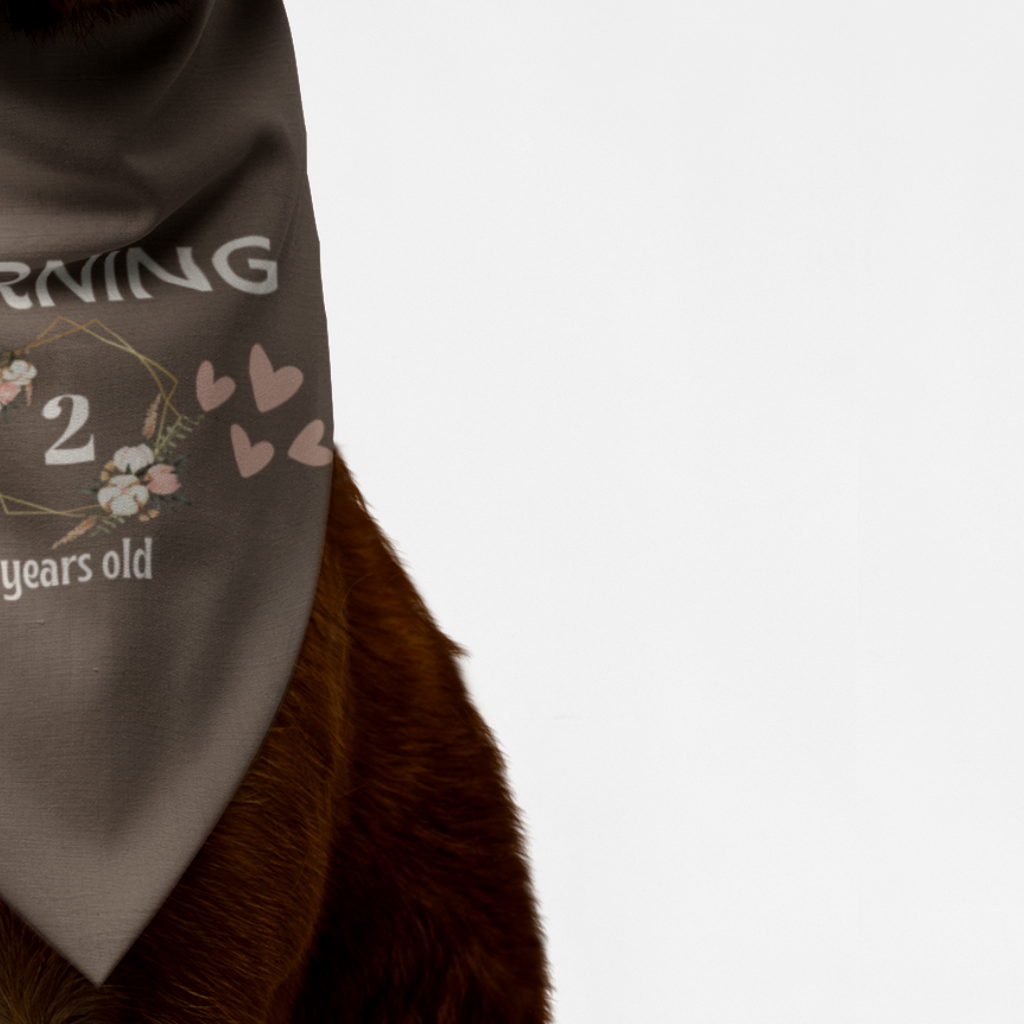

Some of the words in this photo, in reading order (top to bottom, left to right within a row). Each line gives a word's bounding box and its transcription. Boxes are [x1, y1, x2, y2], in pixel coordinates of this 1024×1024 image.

[42, 394, 96, 465] 2
[0, 553, 92, 601] years
[102, 537, 152, 579] old
